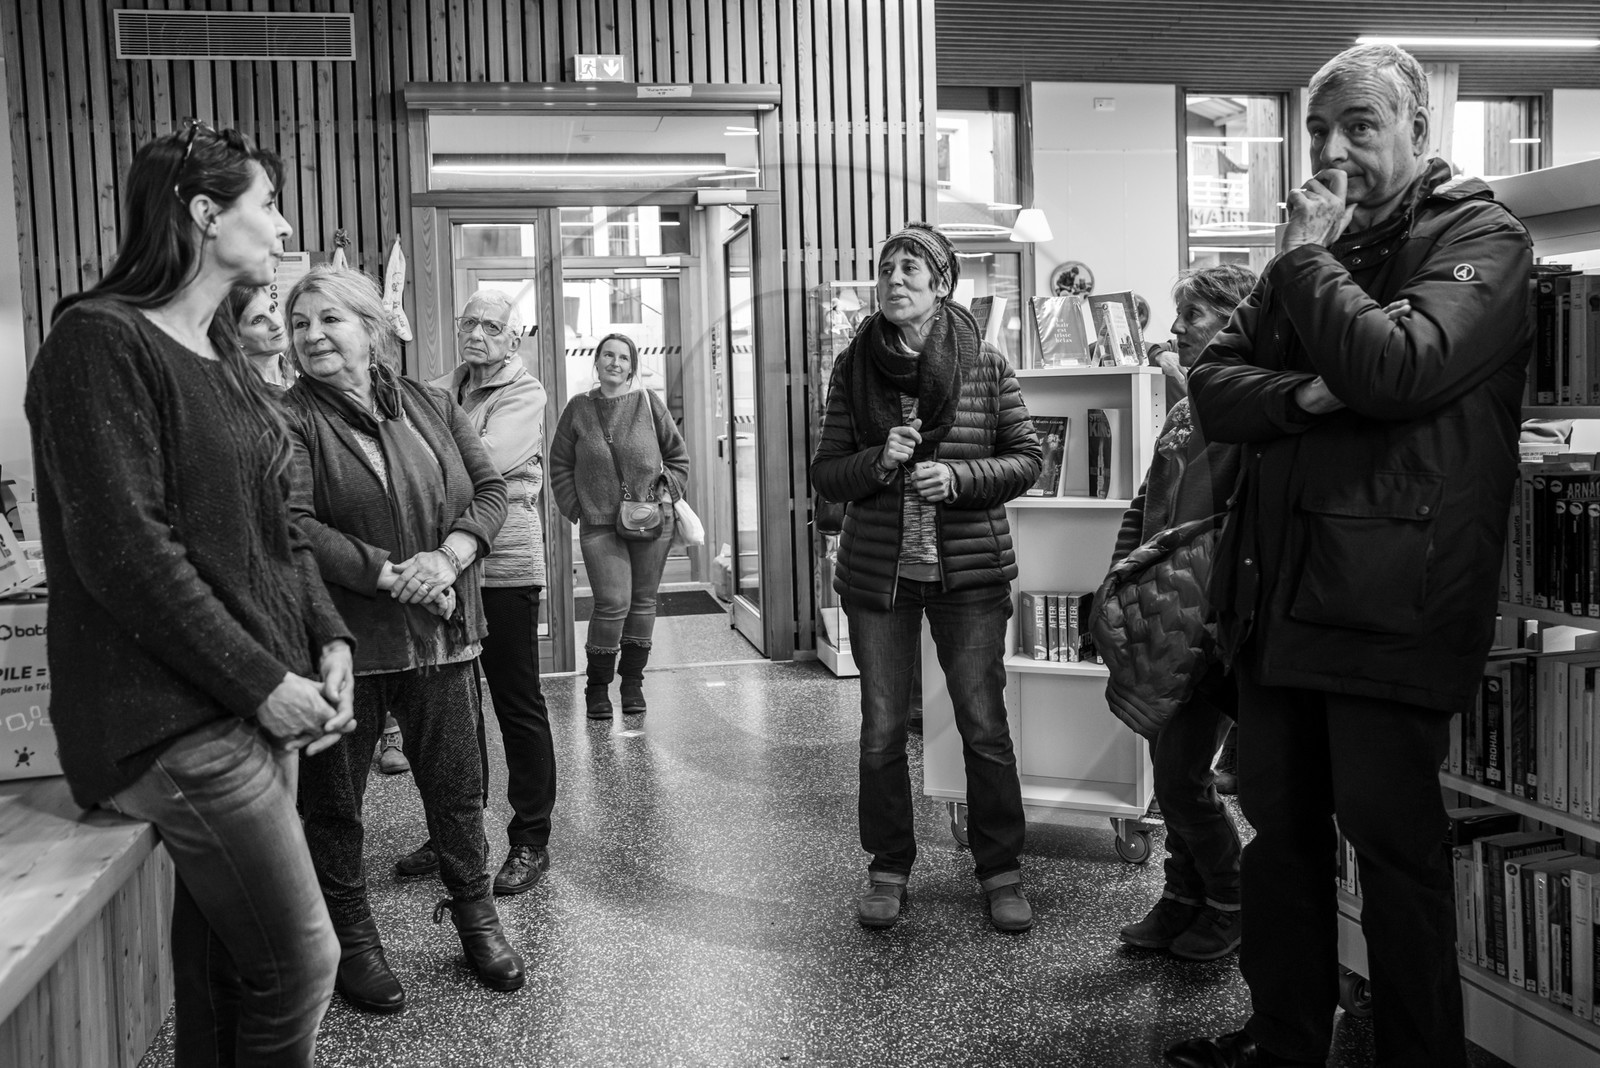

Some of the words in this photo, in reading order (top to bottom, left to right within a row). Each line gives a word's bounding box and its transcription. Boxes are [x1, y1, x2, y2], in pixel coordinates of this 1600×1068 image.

[1036, 606, 1044, 628] AFTER
[1049, 606, 1057, 628] AFTER
[1, 686, 22, 696] pour
[24, 684, 33, 692] le
[36, 683, 50, 691] Tél
